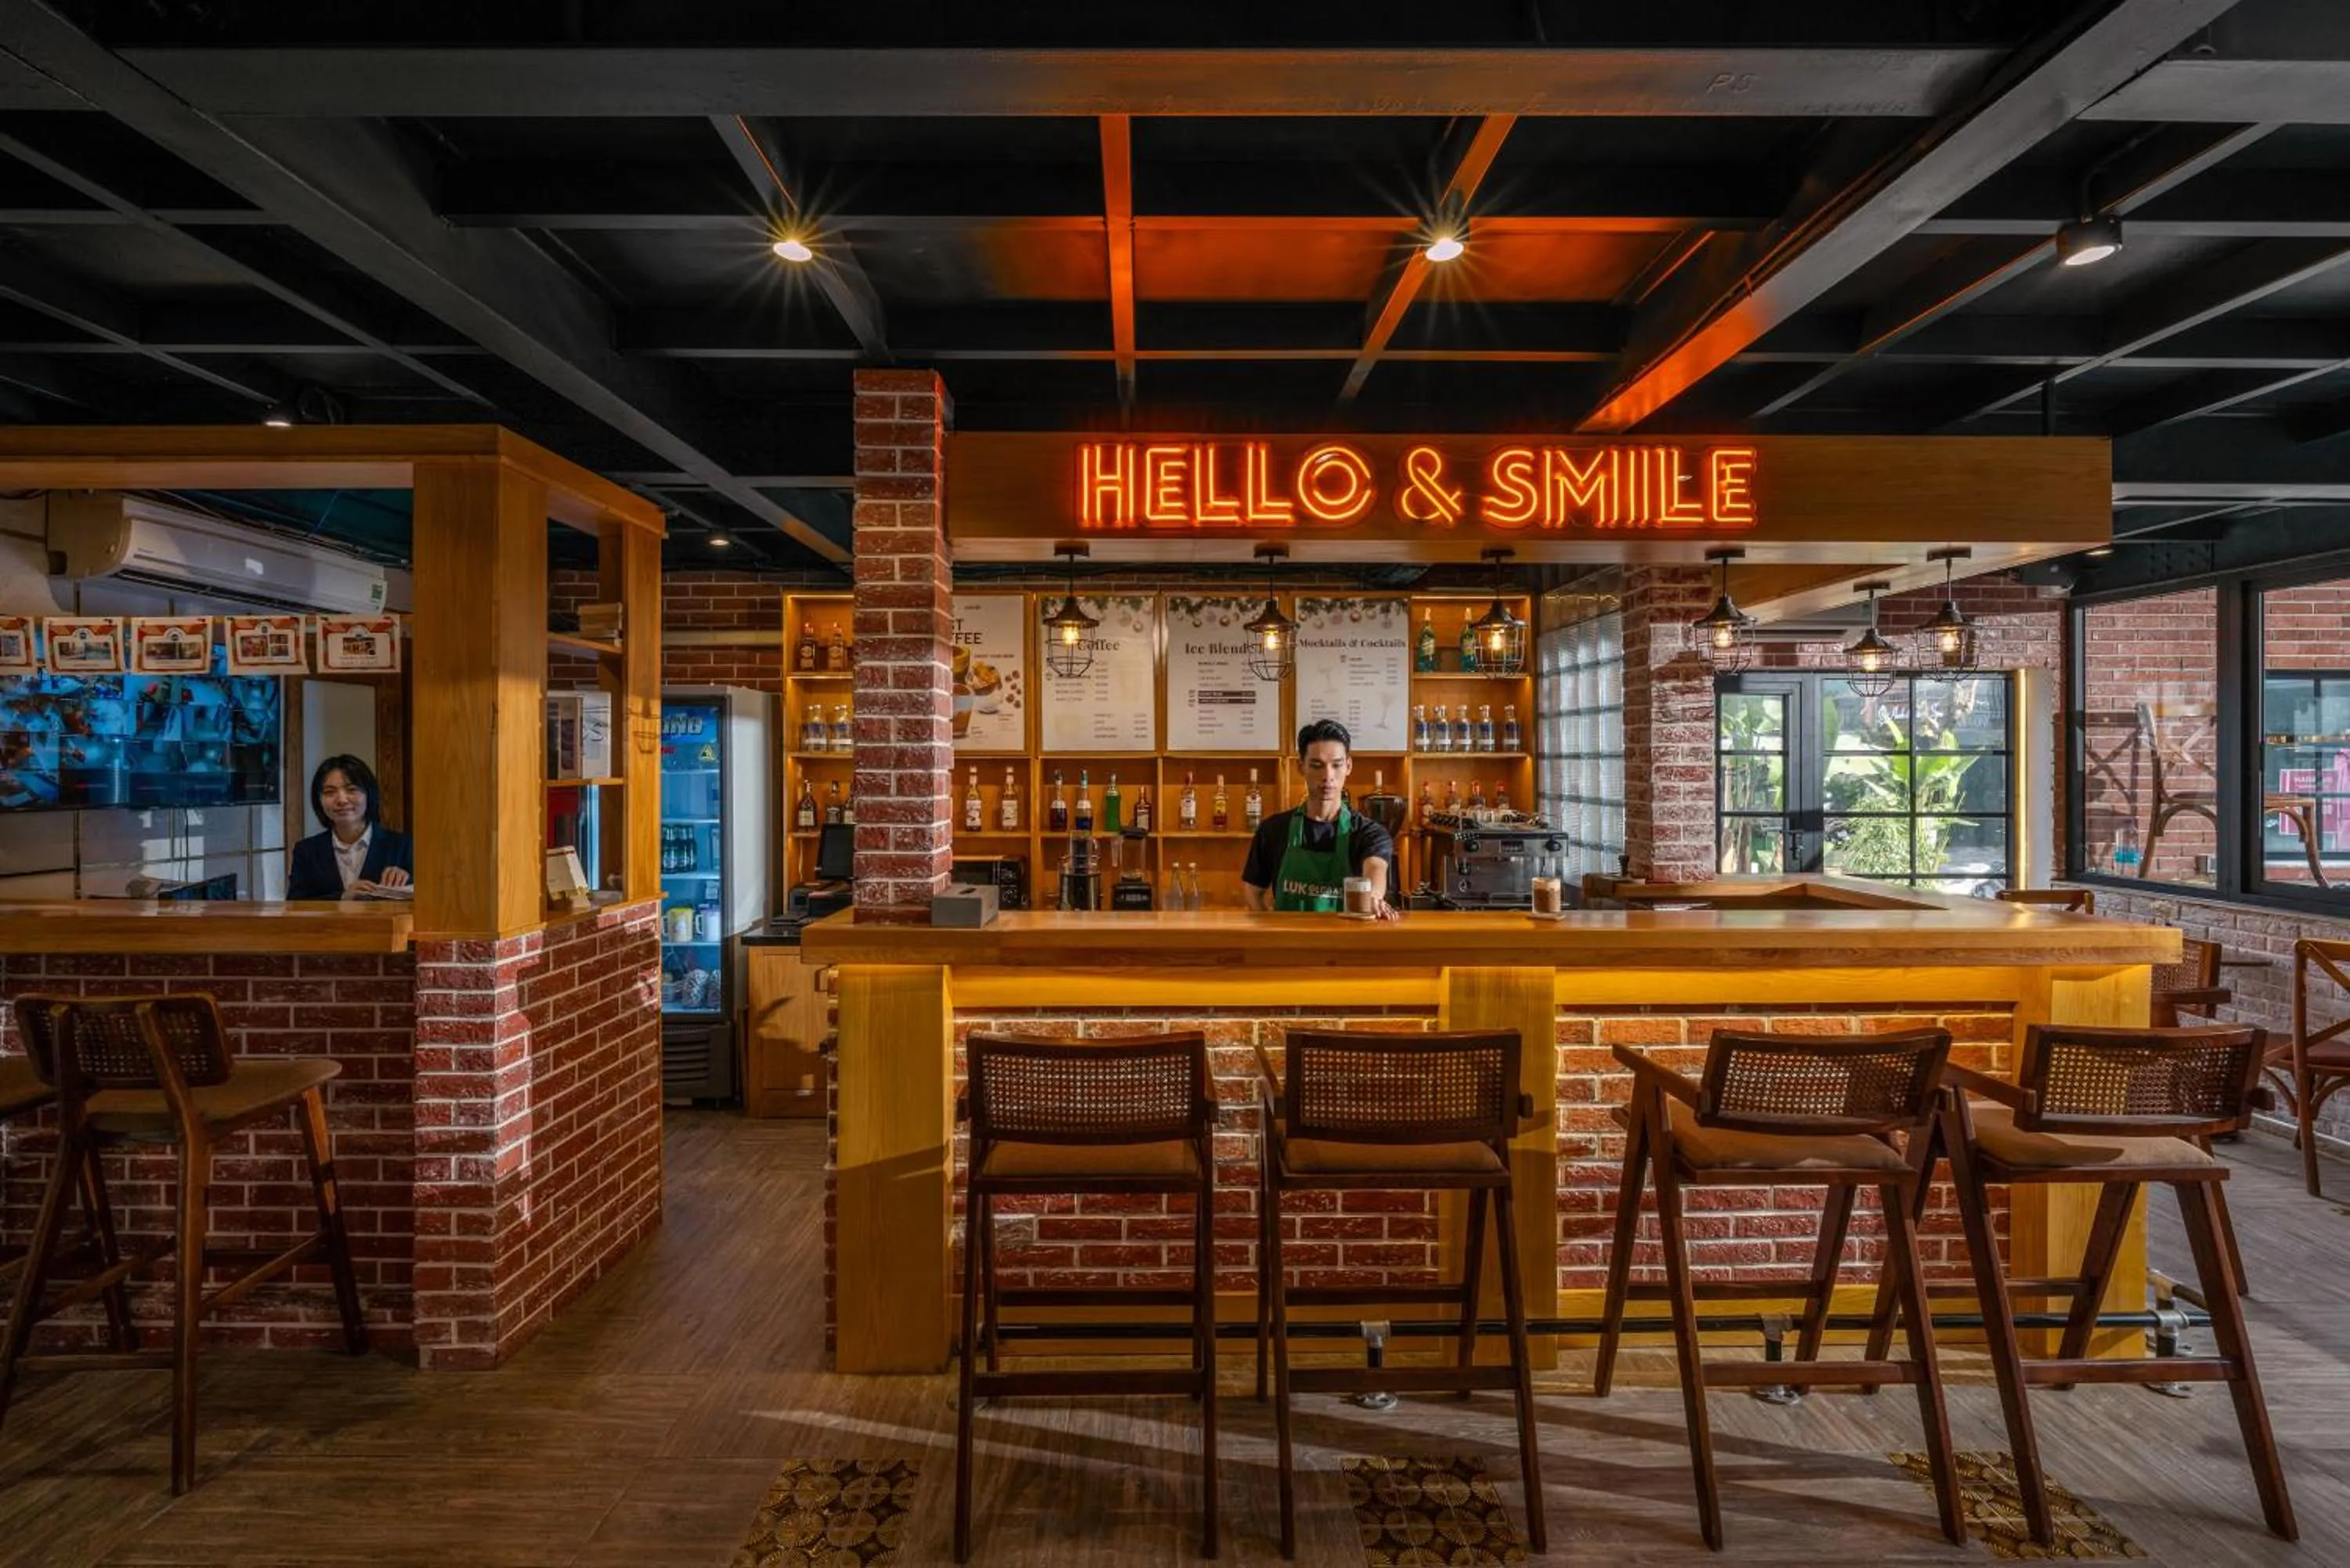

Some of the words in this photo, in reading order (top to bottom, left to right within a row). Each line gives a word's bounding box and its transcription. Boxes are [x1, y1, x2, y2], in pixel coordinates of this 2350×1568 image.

[1079, 443, 1376, 526] HELLO
[1400, 445, 1462, 526] &
[1483, 445, 1758, 528] SMILE
[1078, 638, 1121, 652] Coffee
[1185, 641, 1206, 655] Ice
[1209, 641, 1264, 655] Blendd
[1300, 638, 1347, 649] Mocktails
[1360, 638, 1406, 649] Cocktails
